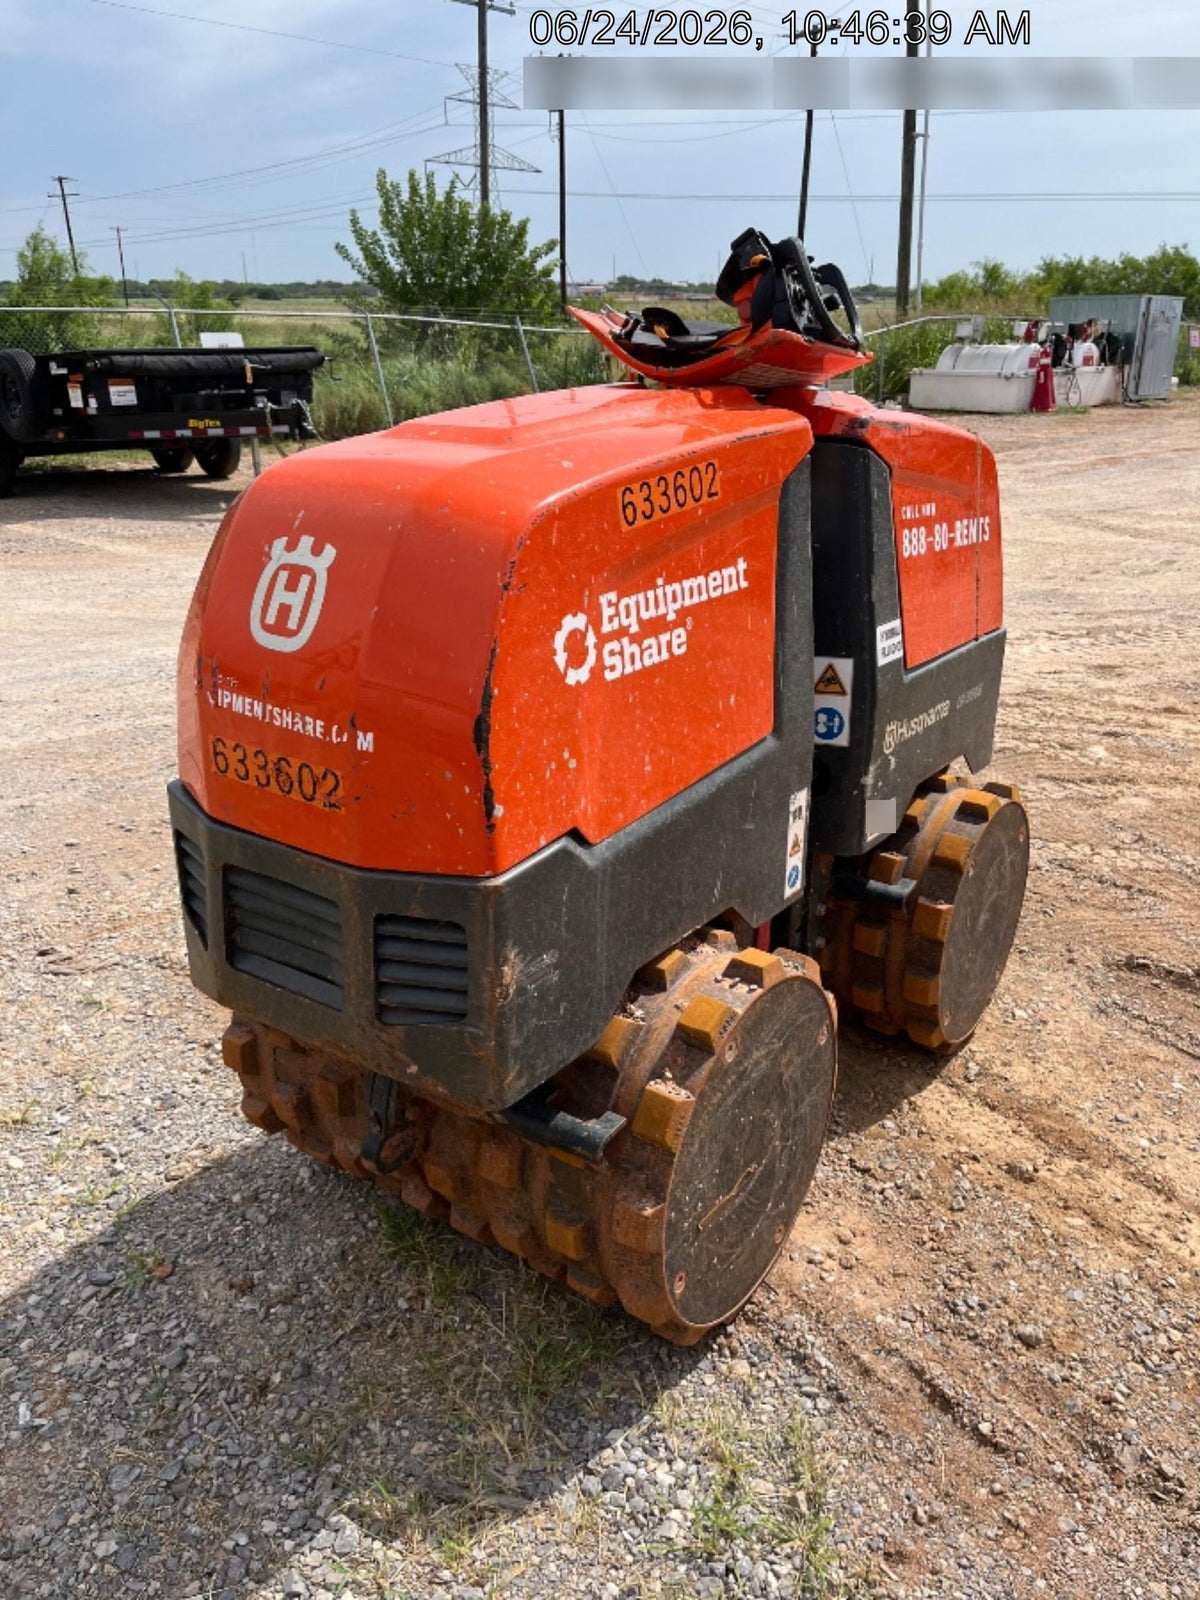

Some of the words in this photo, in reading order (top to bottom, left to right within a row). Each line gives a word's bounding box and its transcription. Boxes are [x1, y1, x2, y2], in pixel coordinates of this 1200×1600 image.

[621, 461, 719, 527] 633602
[902, 515, 990, 559] 888-80-RENTS
[599, 556, 749, 635] Equipment
[212, 737, 342, 811] 633602
